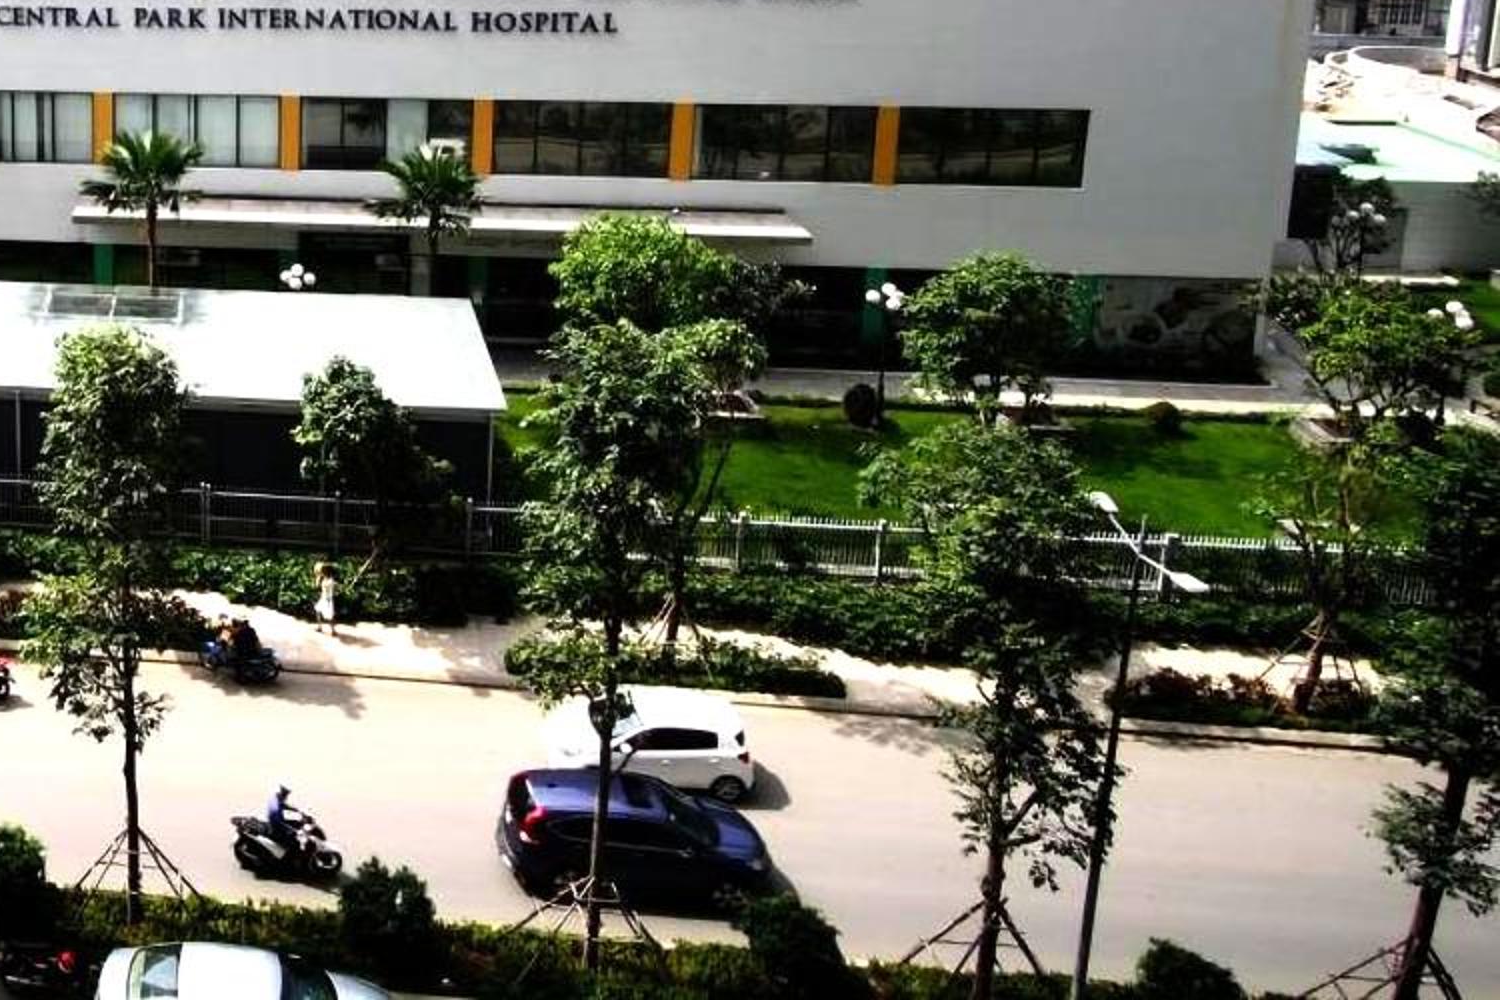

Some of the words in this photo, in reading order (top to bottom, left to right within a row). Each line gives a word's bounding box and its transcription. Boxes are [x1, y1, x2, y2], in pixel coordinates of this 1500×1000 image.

[134, 7, 206, 29] PARK
[218, 7, 457, 32] INTERNATIONAL
[471, 11, 619, 34] HOSPITAL
